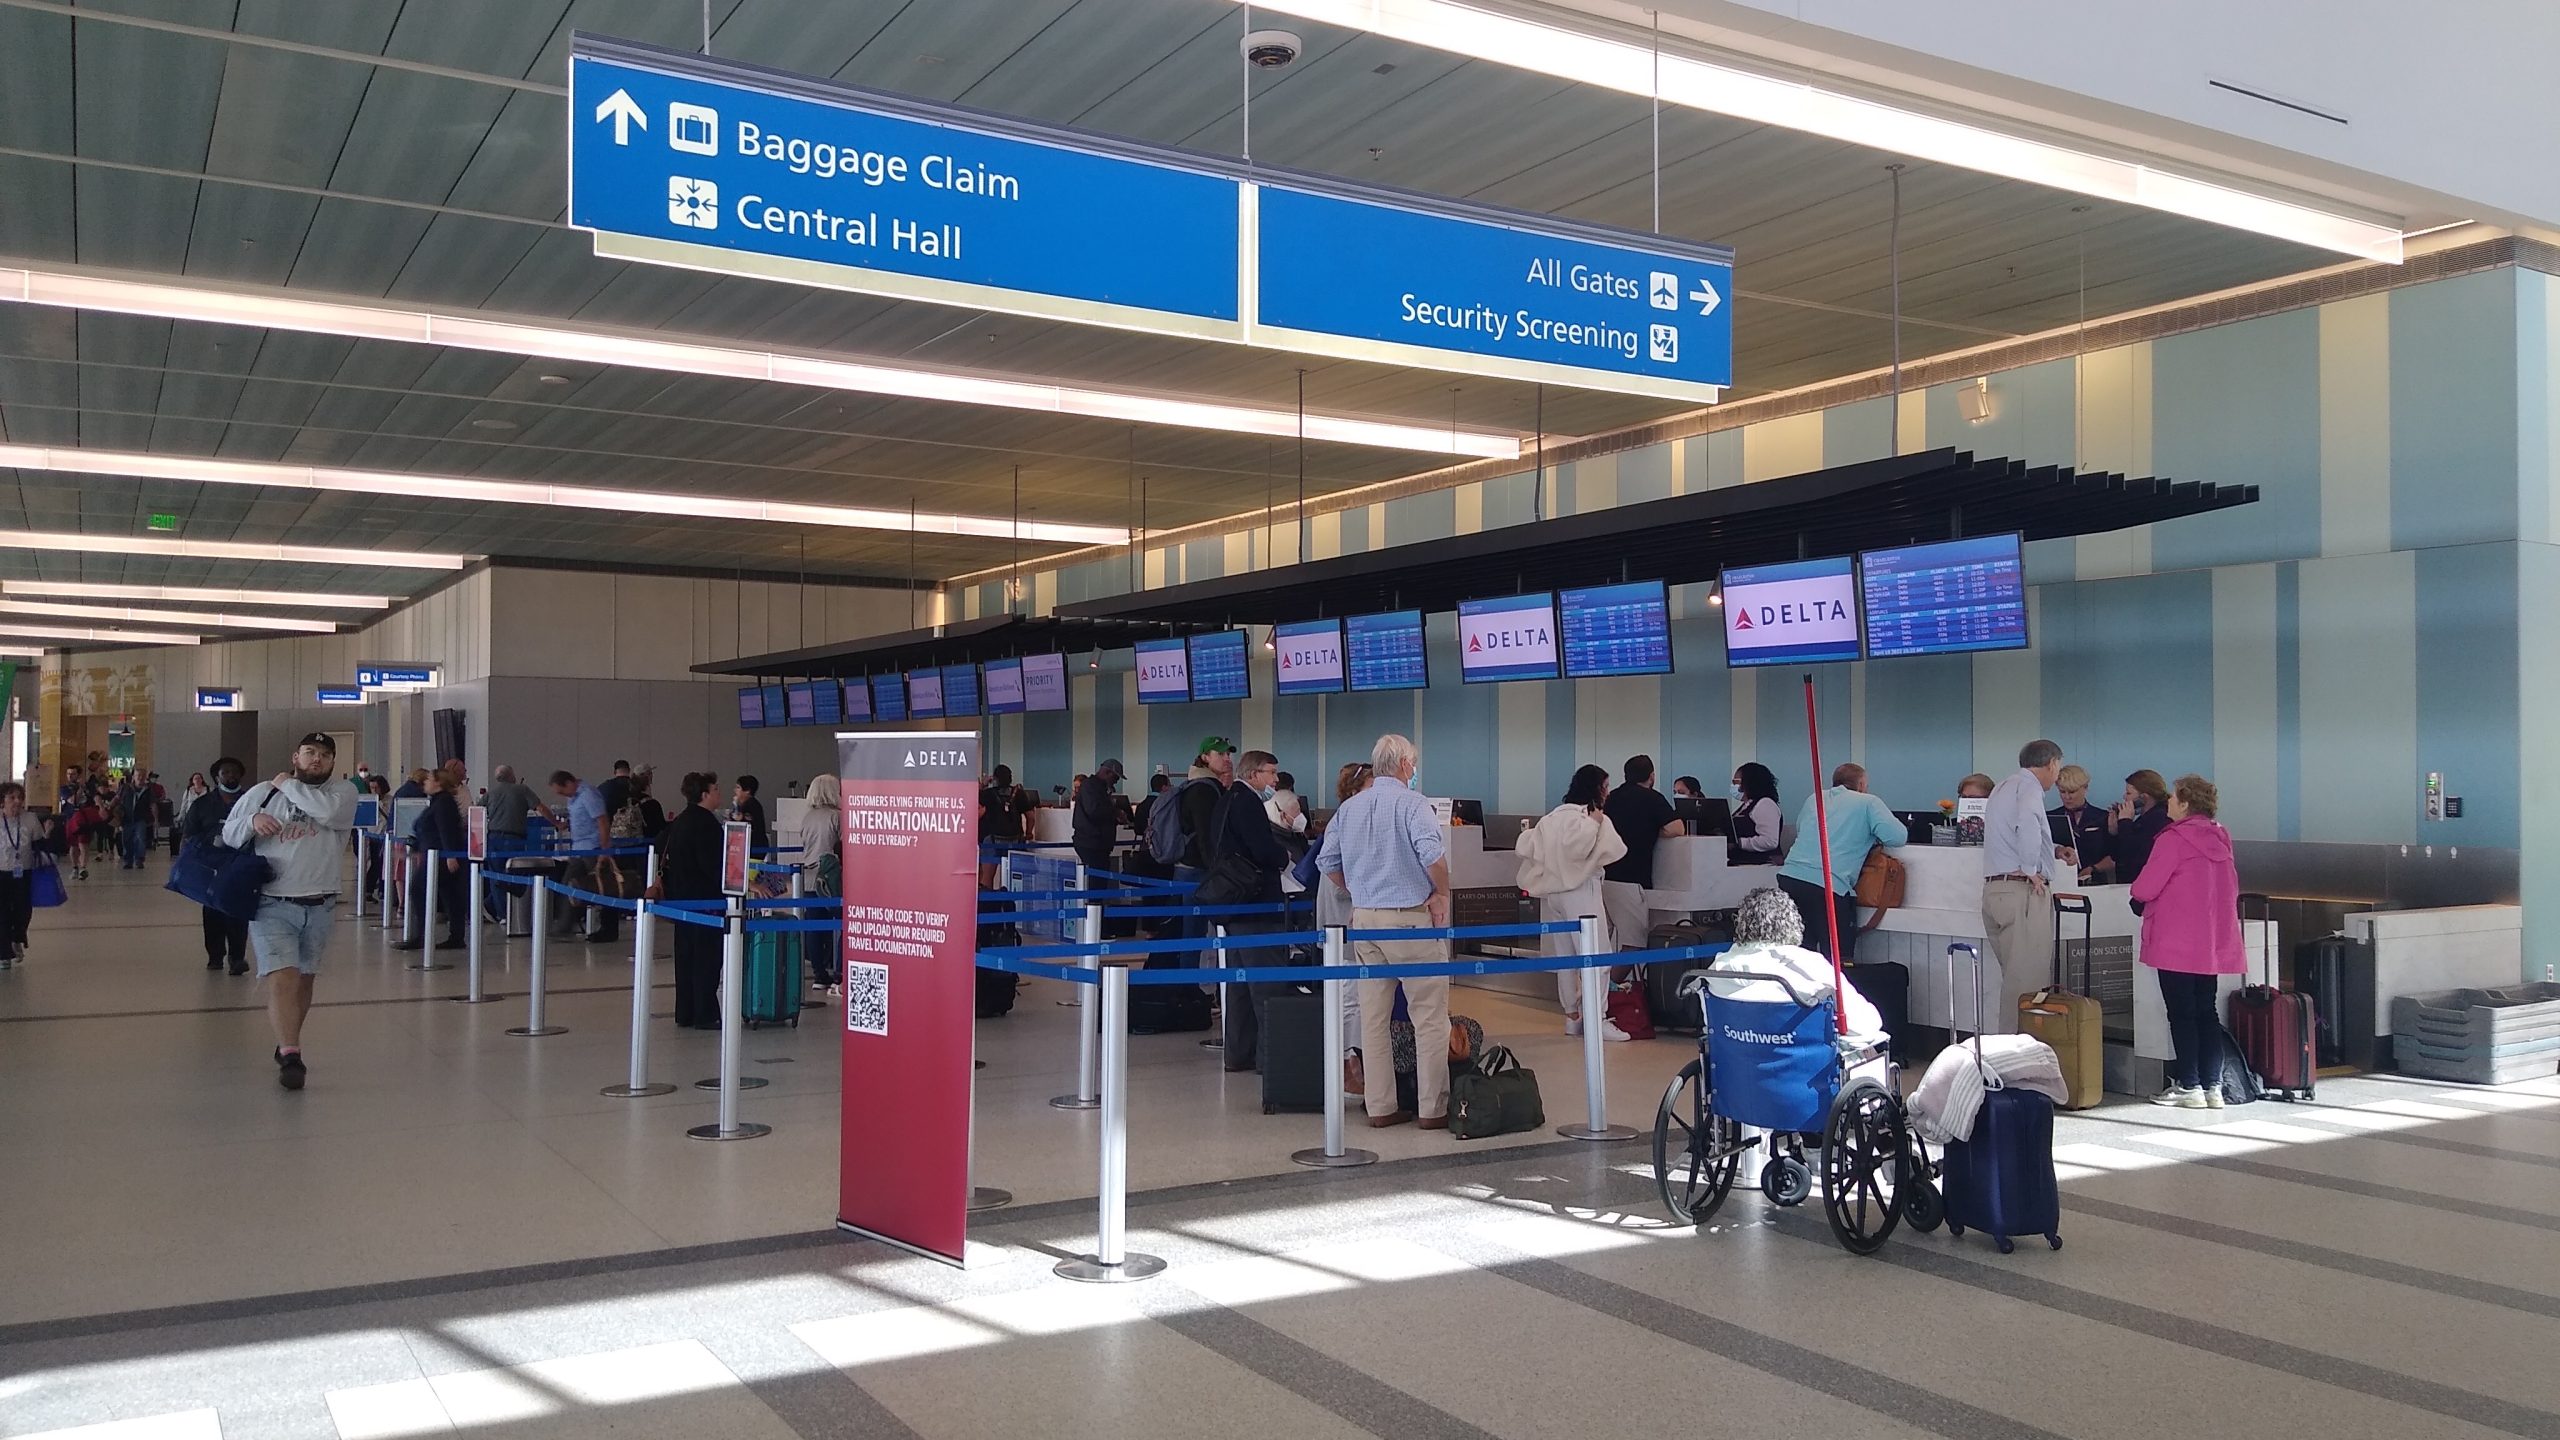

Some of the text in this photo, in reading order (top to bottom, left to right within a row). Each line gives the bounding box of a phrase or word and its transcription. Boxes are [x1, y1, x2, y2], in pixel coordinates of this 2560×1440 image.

[738, 121, 1019, 200] Baggage Claim
[737, 195, 962, 259] Central Hall
[1526, 258, 1639, 299] All Gates
[1401, 294, 1639, 359] Security Screening
[153, 514, 176, 528] EXIT
[1761, 600, 1847, 626] DELTA
[1487, 628, 1549, 649] DELTA
[1295, 649, 1338, 666] DELTA
[1026, 675, 1054, 686] PRIORITY
[1150, 664, 1185, 679] DELTA
[919, 750, 967, 766] DELTA
[848, 795, 966, 809] CUSTOMERS FLYING FROM THE U.S.
[848, 810, 966, 834] INTERNATIONALLY:
[848, 833, 860, 844] ARE
[862, 833, 876, 845] YOU
[848, 905, 949, 927] SCAN THIS QR CODE TO VERIFY
[848, 921, 945, 943] AND UPLOAD YOUR REQUIRED
[848, 936, 934, 958] TRAVEL DOCUMENTATION.
[2071, 947, 2103, 957] CAR-ON
[2104, 946, 2118, 955] SIZE
